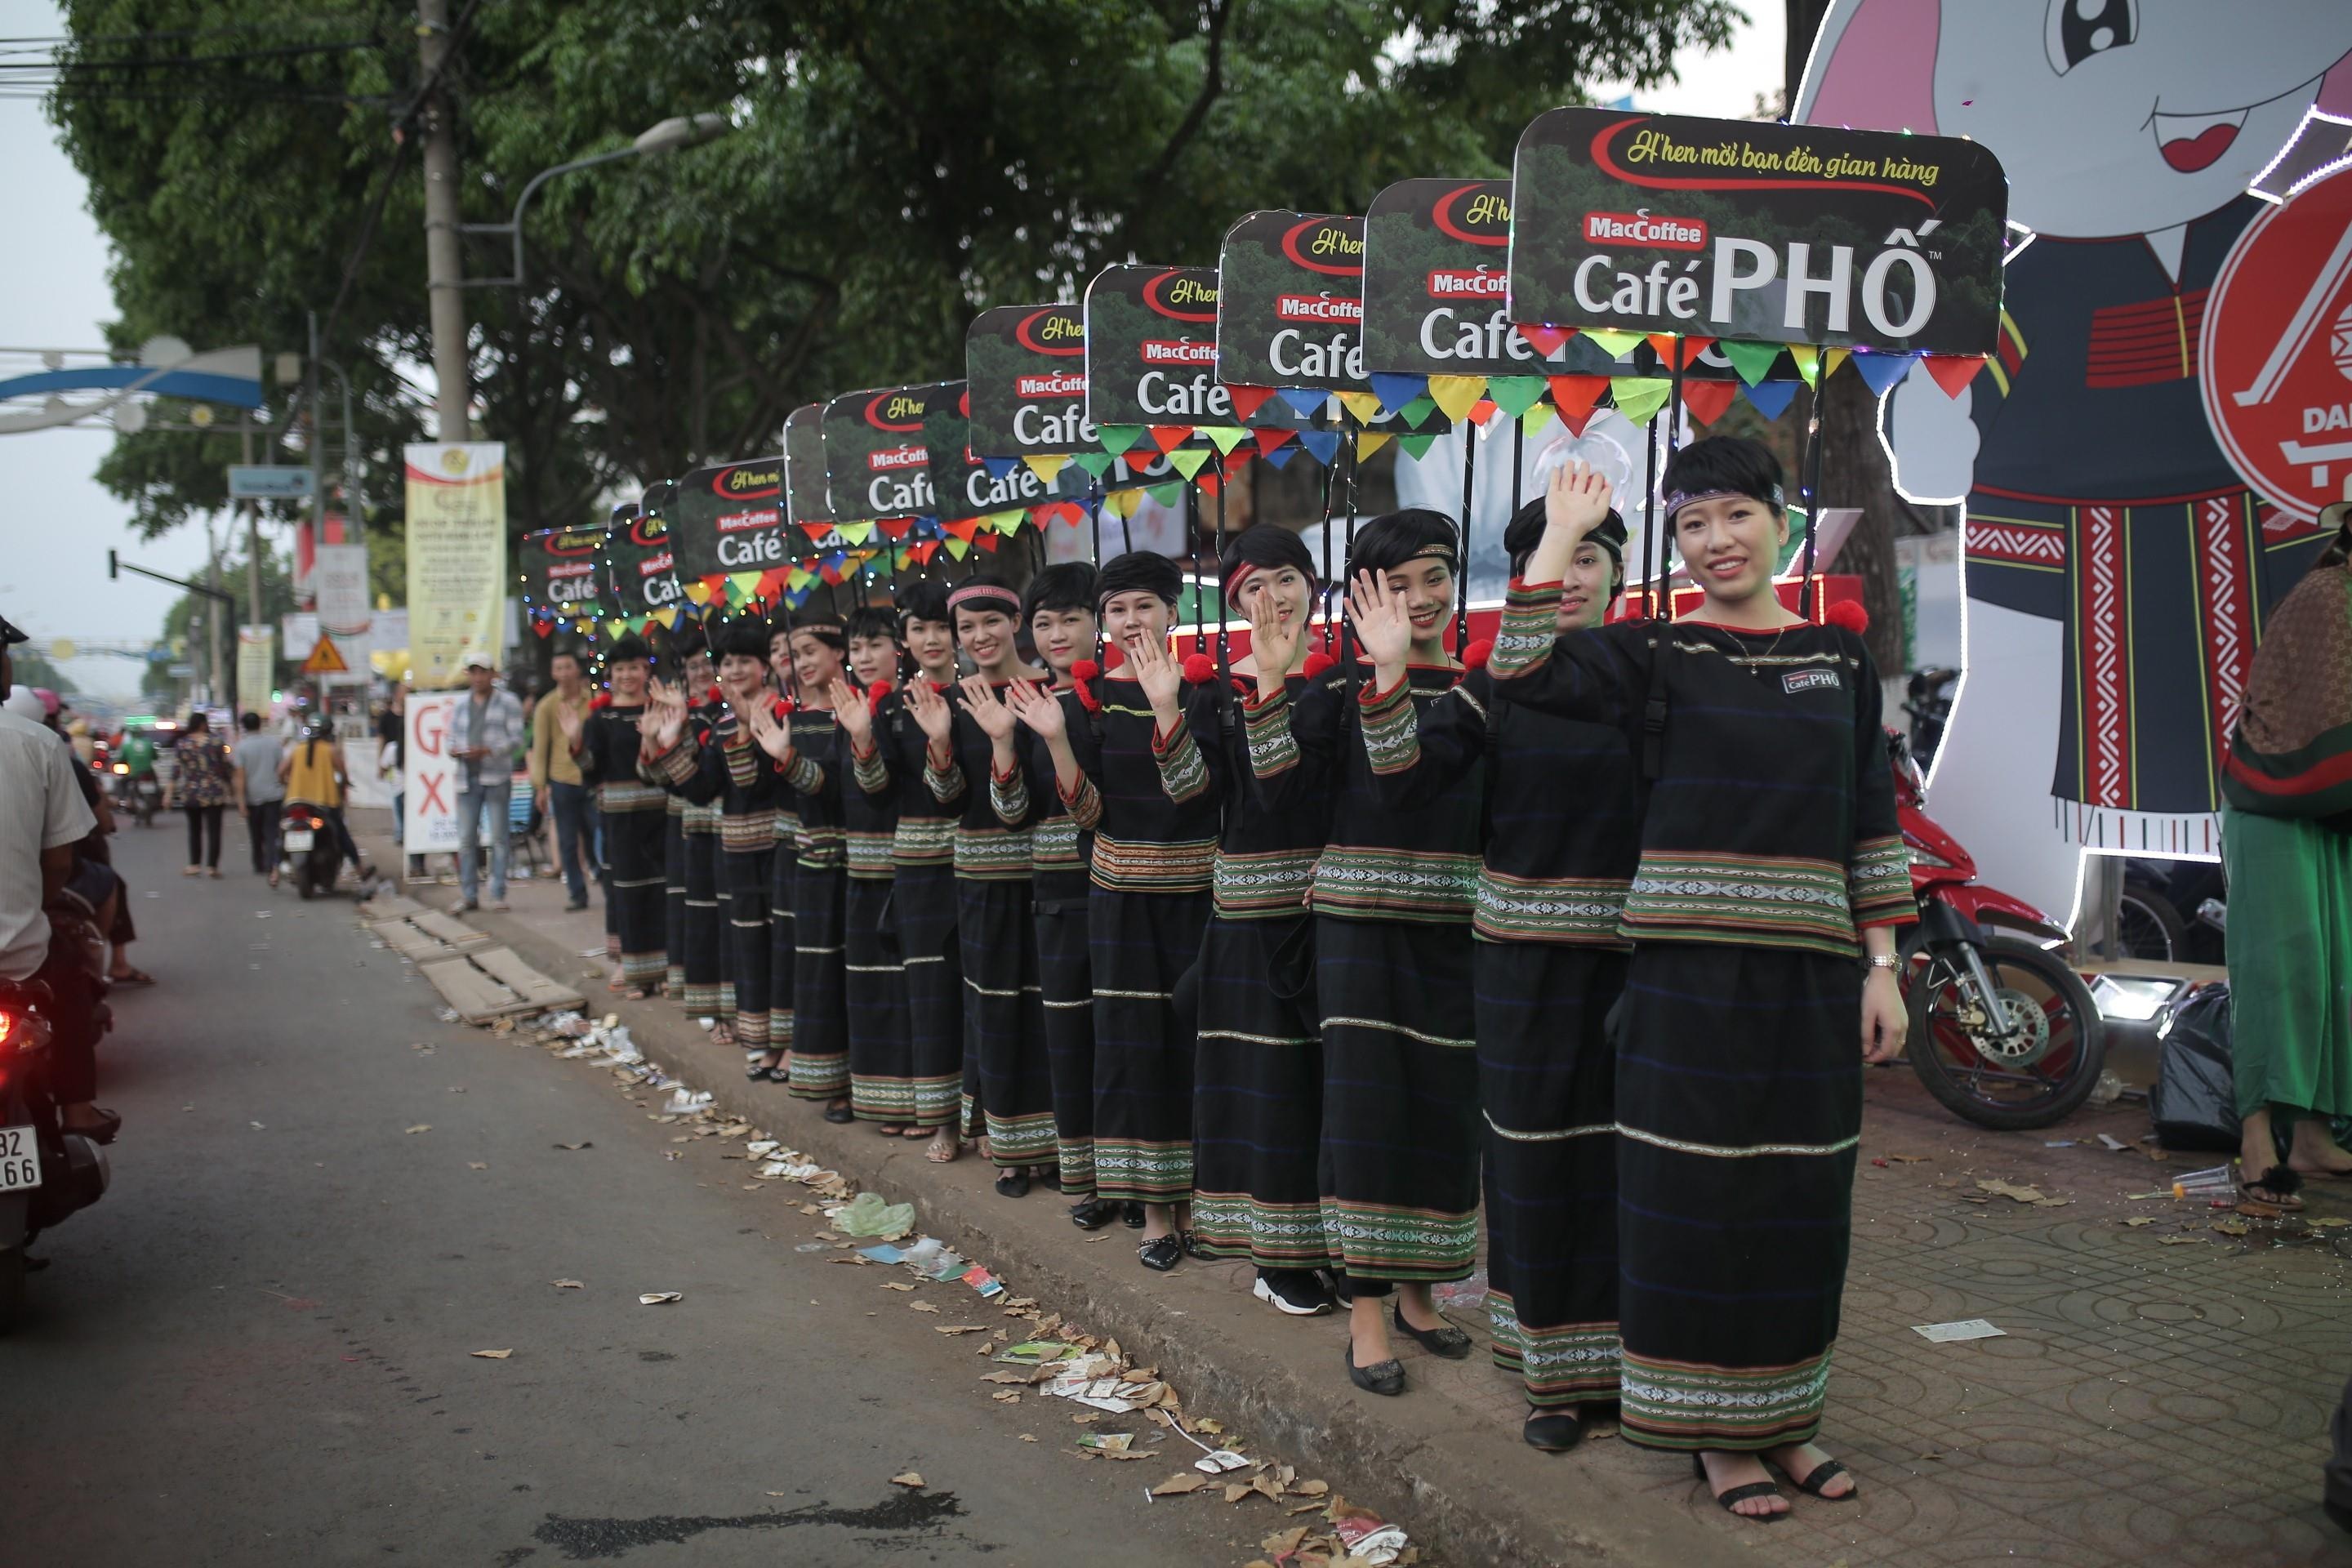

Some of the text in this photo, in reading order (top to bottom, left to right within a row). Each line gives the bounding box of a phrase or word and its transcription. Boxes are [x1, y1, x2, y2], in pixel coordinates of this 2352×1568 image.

[1628, 129, 1940, 186] H'hen mời bạn đến gian hàng
[1588, 215, 1703, 243] MacCoffee
[1574, 255, 1702, 320] Café
[1710, 219, 1943, 338] PHỐ
[1281, 298, 1362, 318] MacCoffe
[1146, 344, 1218, 361] MacCoffe
[2303, 403, 2352, 434] DA
[871, 448, 929, 468] MacCoff
[717, 528, 782, 567] Café
[548, 574, 595, 603] Café
